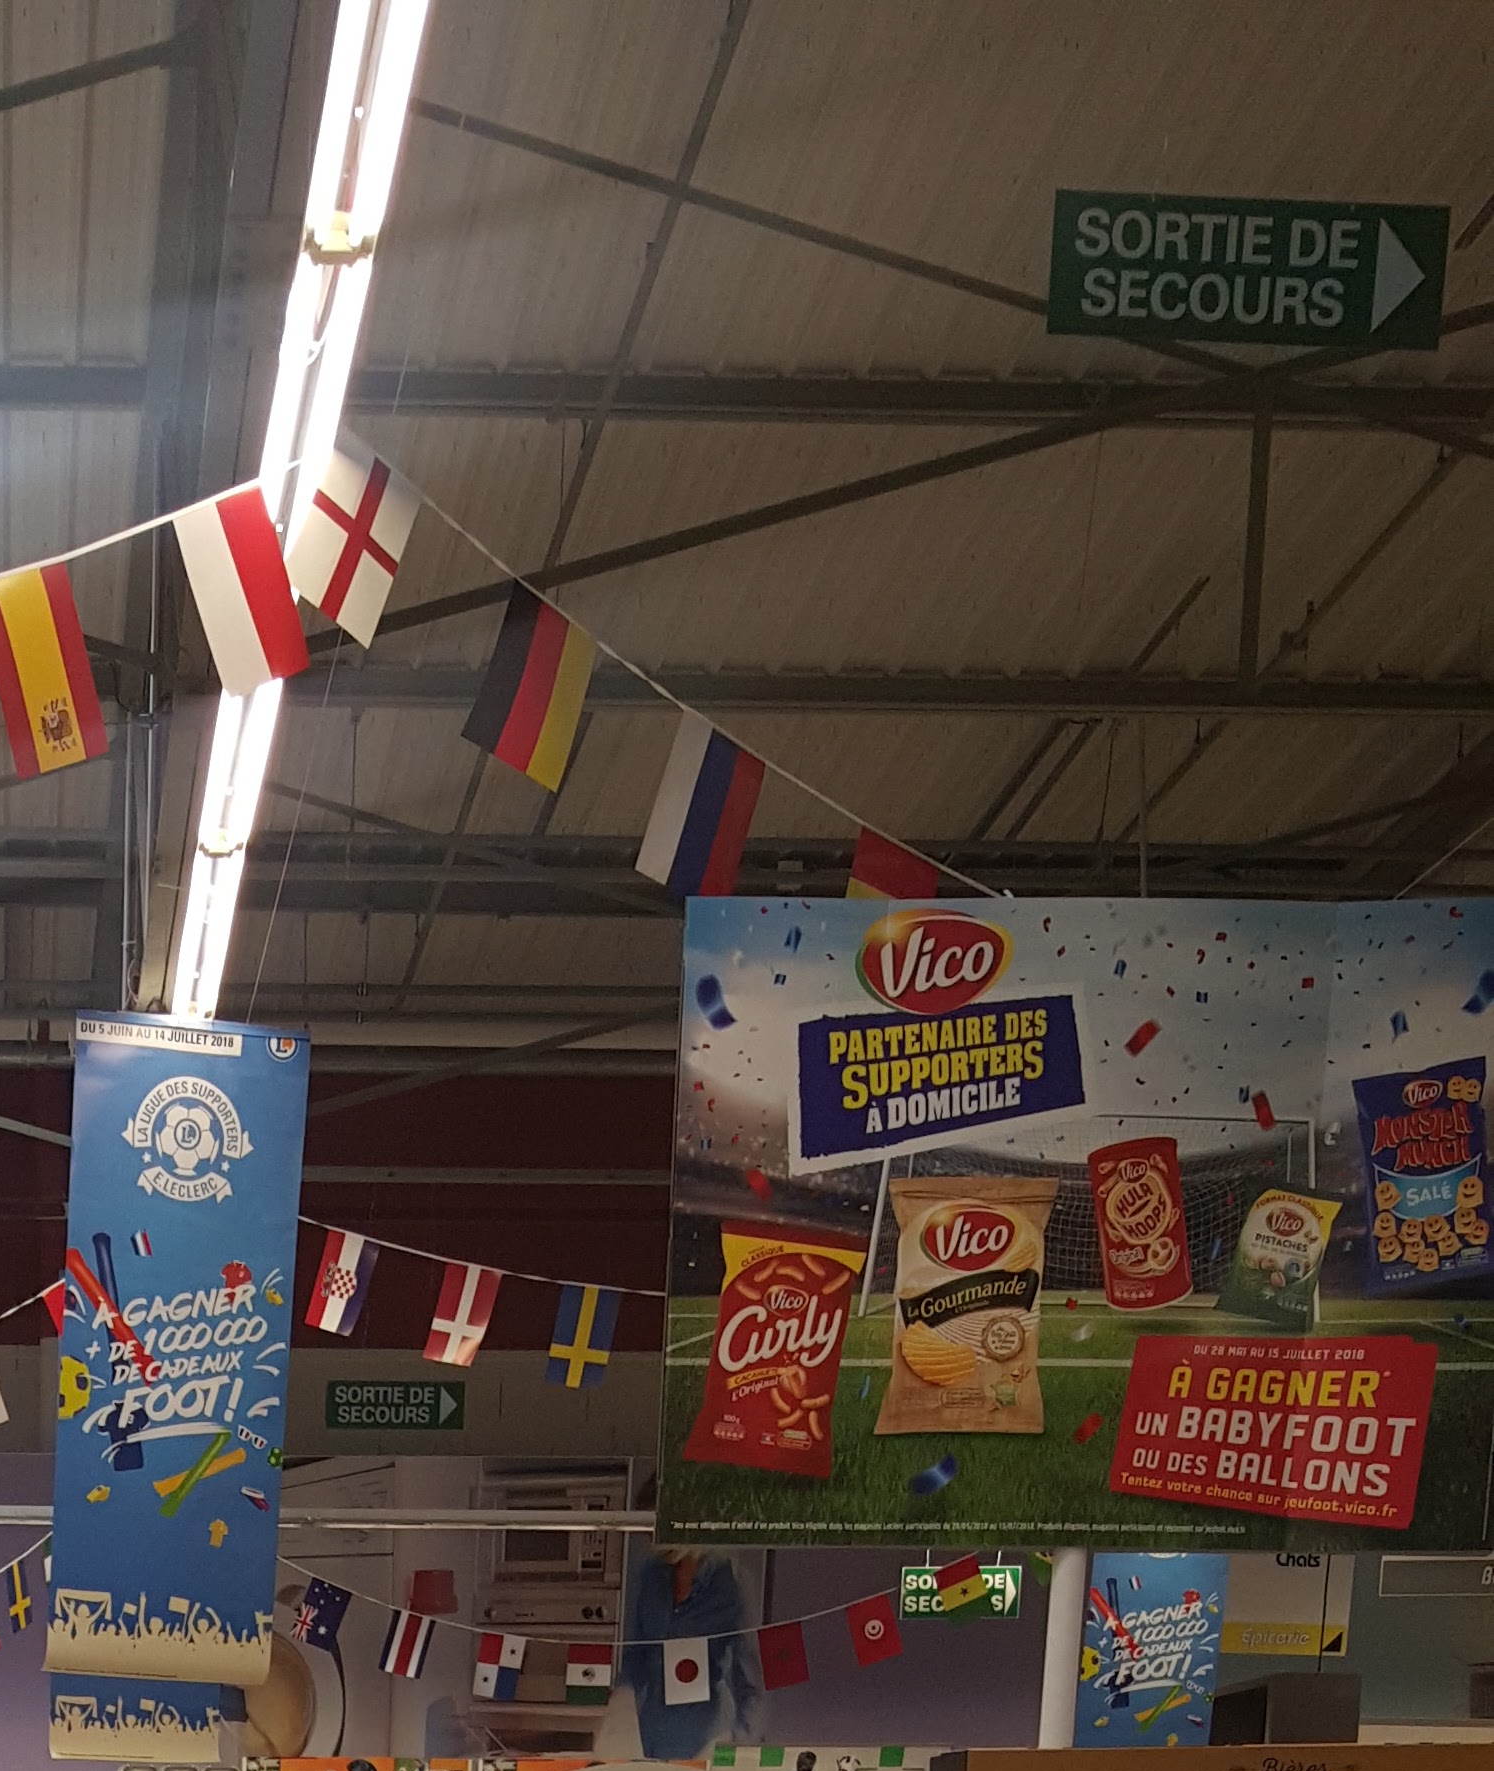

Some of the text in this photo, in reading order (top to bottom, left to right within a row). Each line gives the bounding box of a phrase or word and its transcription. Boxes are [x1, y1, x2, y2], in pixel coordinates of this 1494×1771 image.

[1074, 207, 1362, 270] SORTIE DE
[1080, 267, 1345, 328] SECOURS
[879, 926, 995, 999] Vico
[80, 1023, 235, 1049] DU 5 JUIN AU 14 JUILLET 2018
[829, 1009, 1048, 1066] PARTENAIRE DES
[841, 1040, 1045, 1110] SUPPORTERS
[137, 1081, 238, 1156] LA LIGUE DES SUPPORTERS
[865, 1077, 1021, 1134] À DOMICILE
[153, 1170, 219, 1199] E.LECLERC
[1114, 1183, 1154, 1218] HULA
[1405, 1182, 1453, 1208] SALÉ
[934, 1215, 1010, 1262] Vico
[1268, 1212, 1304, 1234] Vico
[1254, 1233, 1308, 1254] PISTACHES
[91, 1284, 256, 1330] À GAGNER
[769, 1289, 804, 1311] Vico
[919, 1275, 1028, 1319] Gourmande
[108, 1340, 137, 1363] DE
[717, 1295, 843, 1373] Curly
[113, 1350, 244, 1386] DE CADEAUX
[1193, 1344, 1209, 1356] DU
[1211, 1345, 1226, 1356] 28
[1228, 1346, 1248, 1357] MAI
[1250, 1346, 1266, 1358] AU
[1268, 1347, 1280, 1359] 15
[1282, 1347, 1331, 1361] JUILLET
[334, 1386, 435, 1405] SORTIE DE
[1168, 1359, 1193, 1400] À
[337, 1405, 430, 1424] SECOURS
[1135, 1405, 1417, 1457] UN BABYFOOT
[1120, 1472, 1163, 1490] Tentez
[1167, 1480, 1202, 1496] votre
[1206, 1484, 1253, 1503] chance
[1257, 1493, 1282, 1507] sur
[1132, 1448, 1391, 1498] OU DES BALLONS
[1275, 1553, 1321, 1568] Chats
[1121, 1601, 1203, 1629] GAGNER
[1132, 1639, 1193, 1660] CADEAUX
